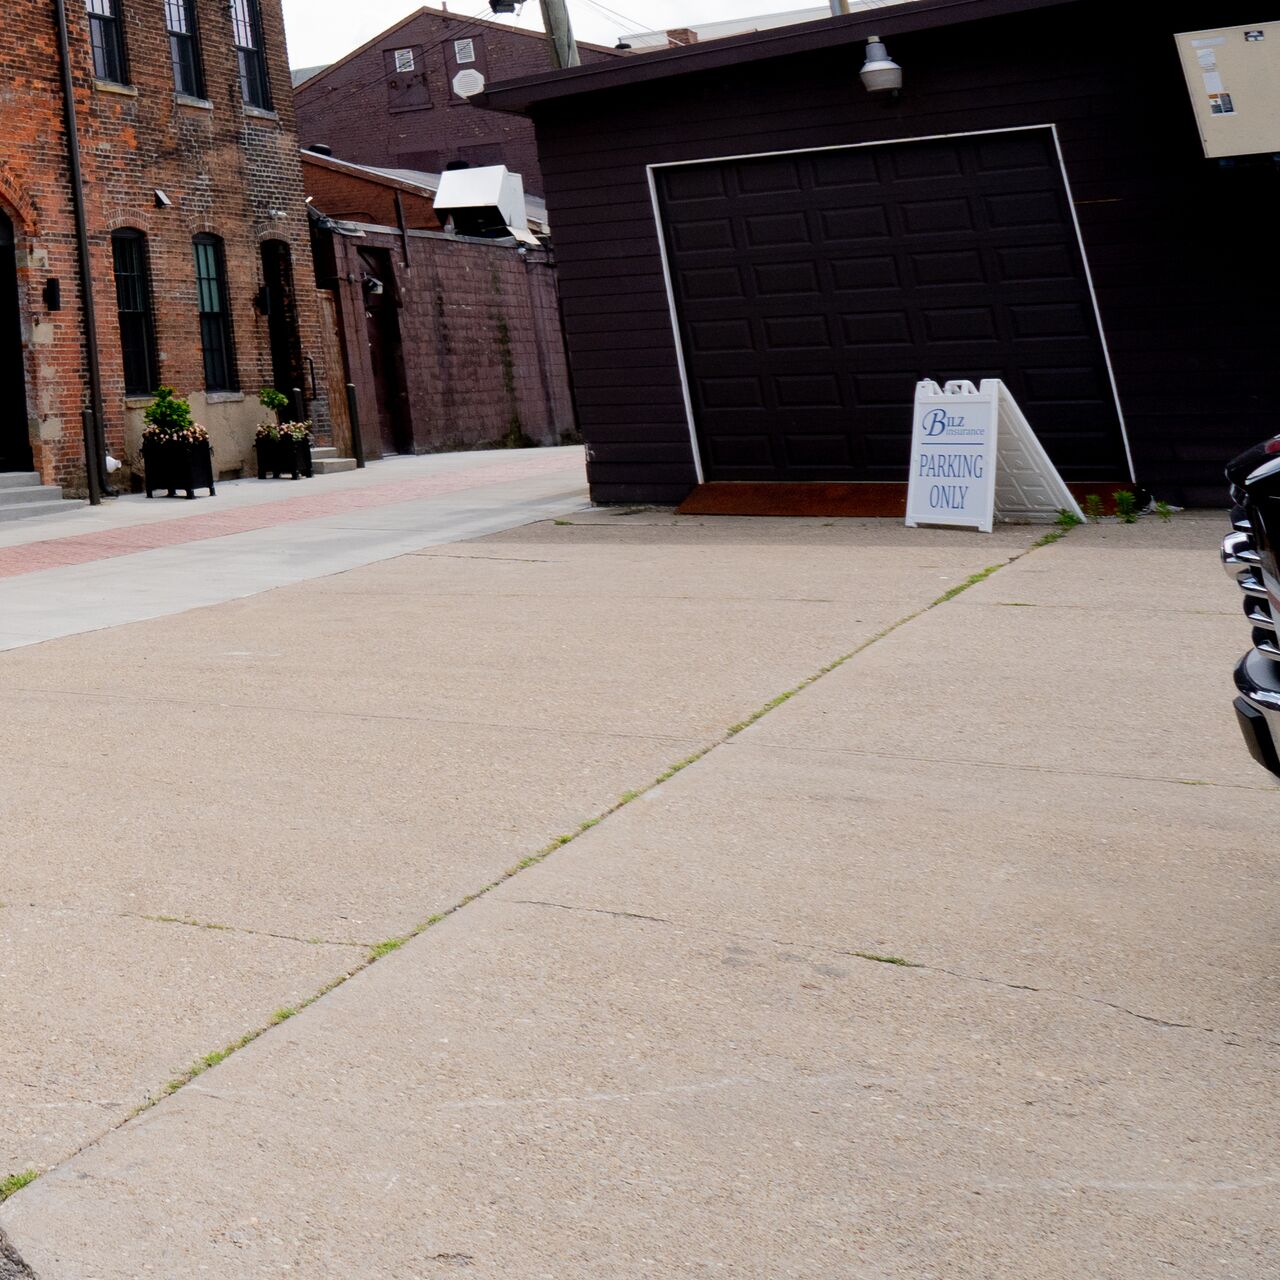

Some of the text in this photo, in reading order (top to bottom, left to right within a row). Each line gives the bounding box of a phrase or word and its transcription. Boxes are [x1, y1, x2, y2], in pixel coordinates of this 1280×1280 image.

[922, 408, 965, 436] BILZ
[946, 428, 985, 436] insurance
[919, 454, 983, 478] PARKING
[929, 485, 969, 509] ONLY
